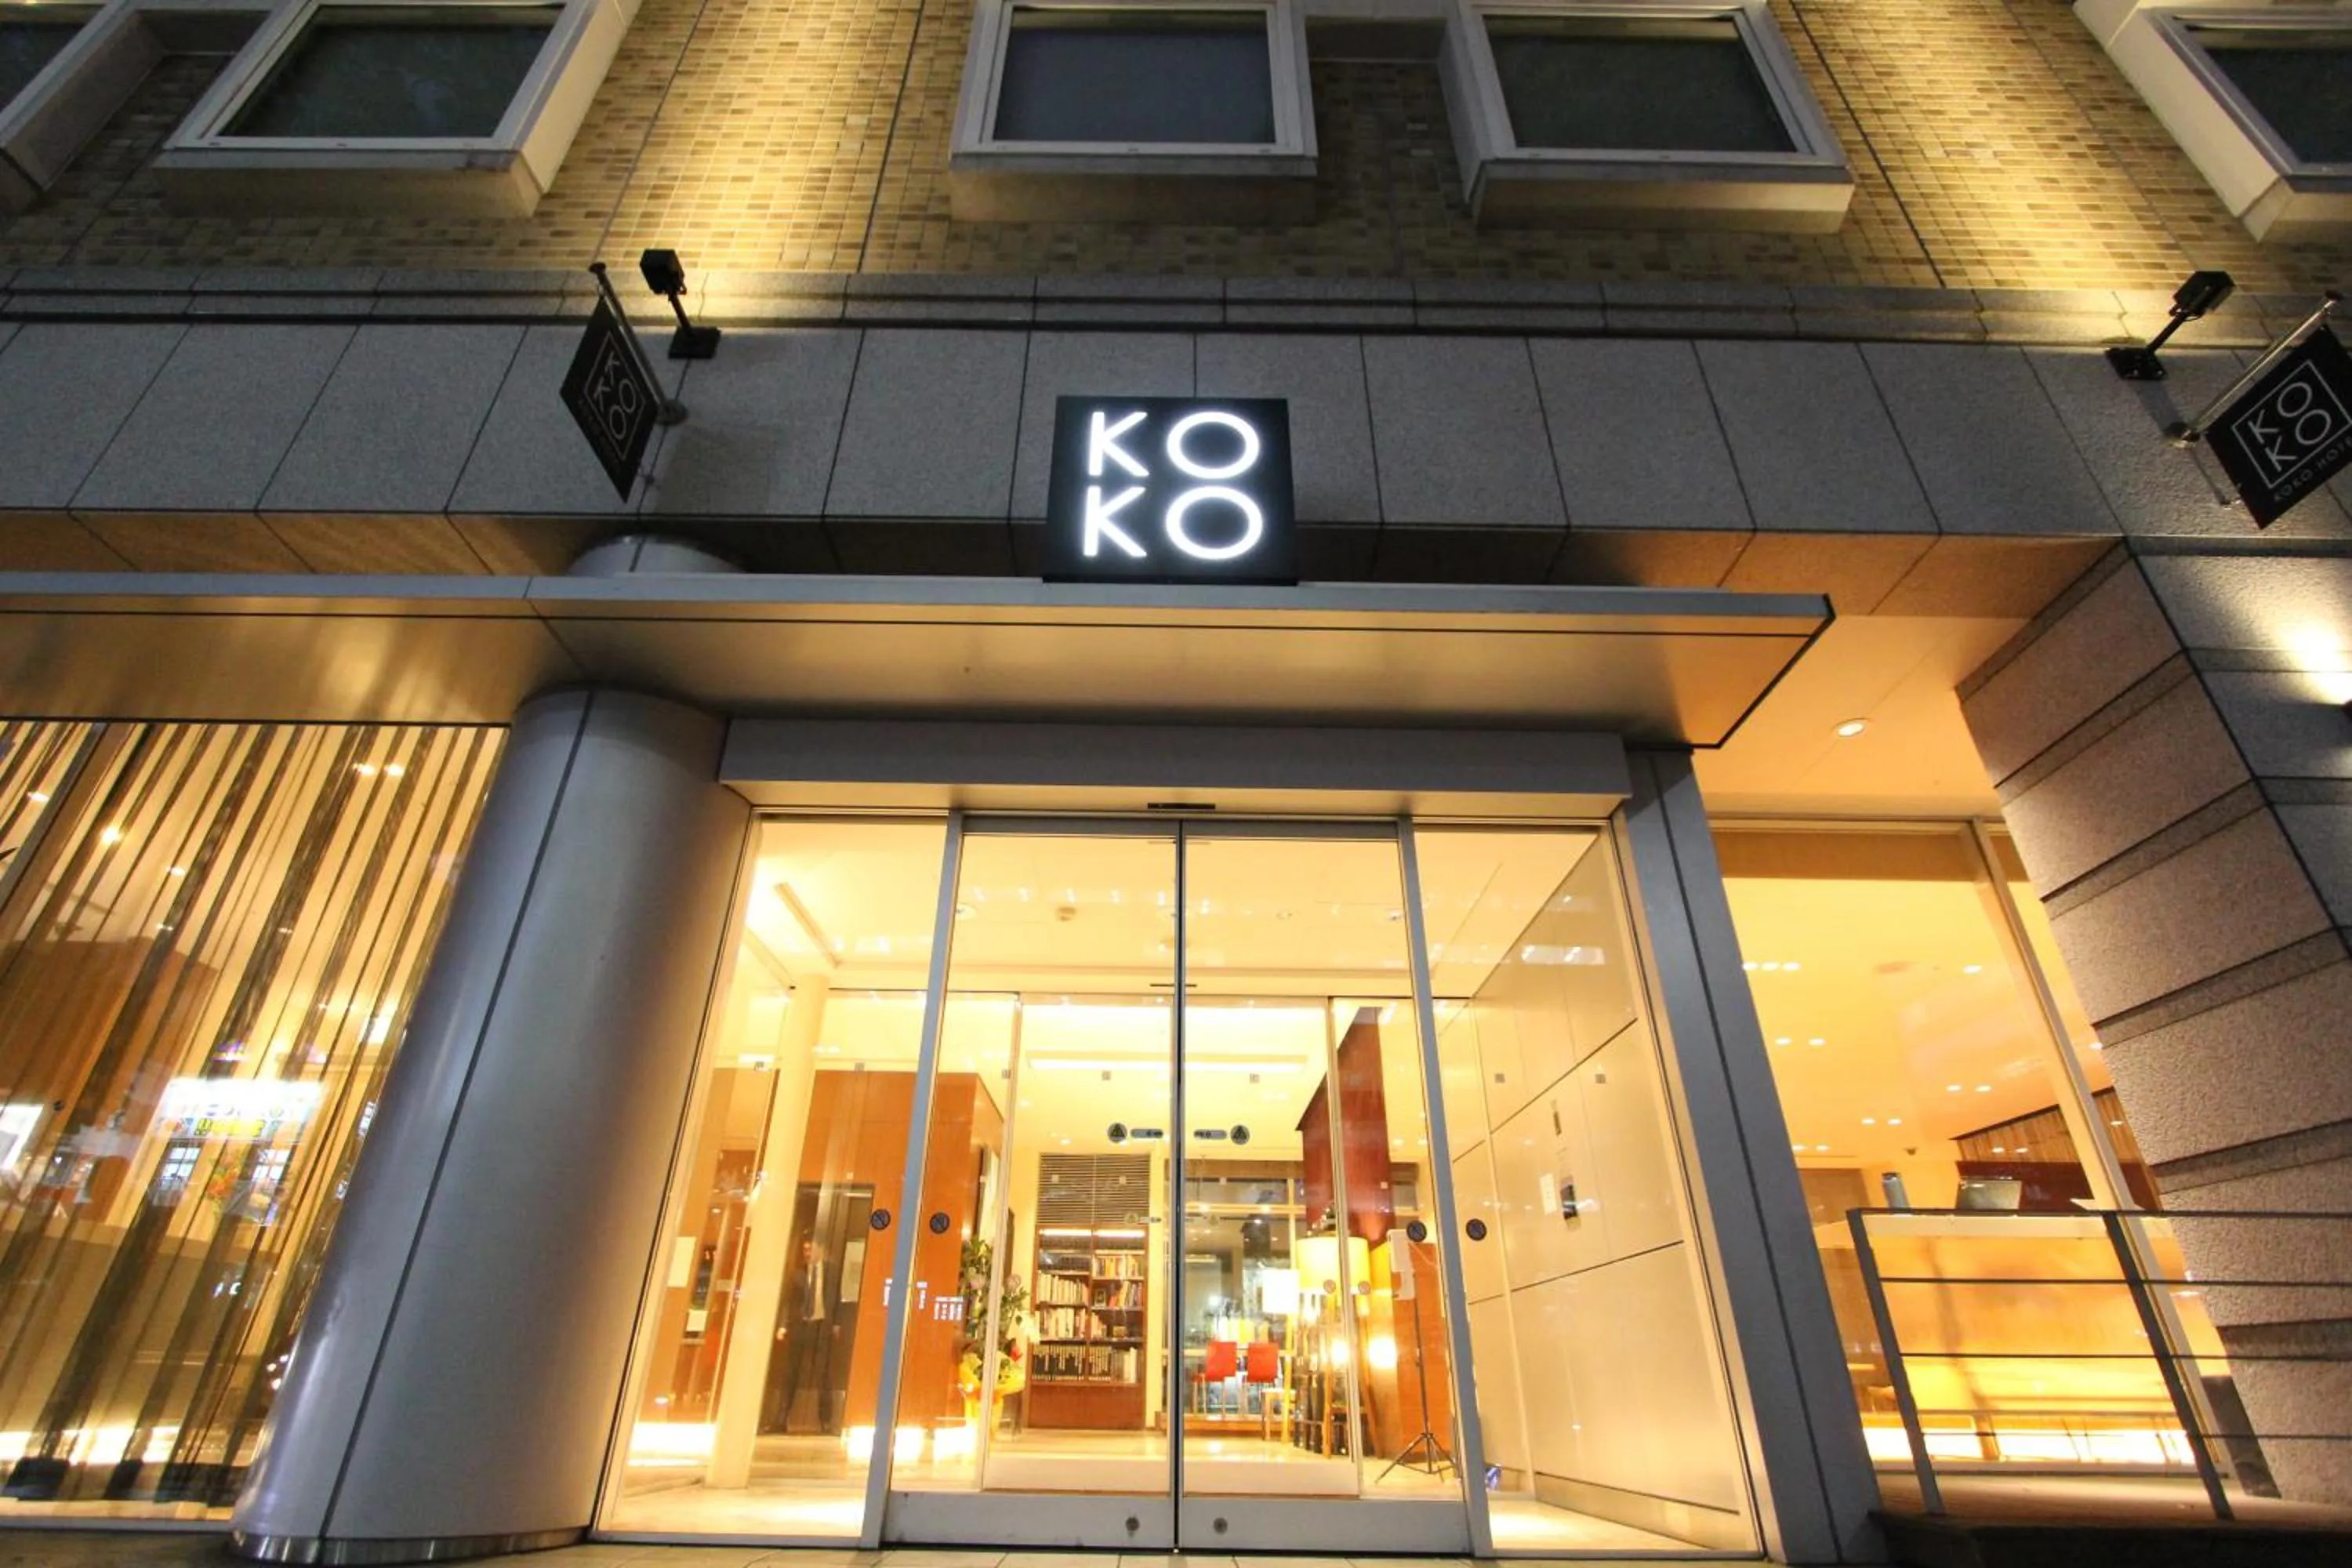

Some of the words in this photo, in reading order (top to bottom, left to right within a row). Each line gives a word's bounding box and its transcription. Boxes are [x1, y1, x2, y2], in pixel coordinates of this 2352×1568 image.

[593, 376, 627, 441] KO
[604, 350, 637, 413] KO
[2247, 381, 2313, 445] KO
[1088, 411, 1260, 479] KO
[2264, 408, 2332, 472] KO
[1083, 485, 1263, 560] KO
